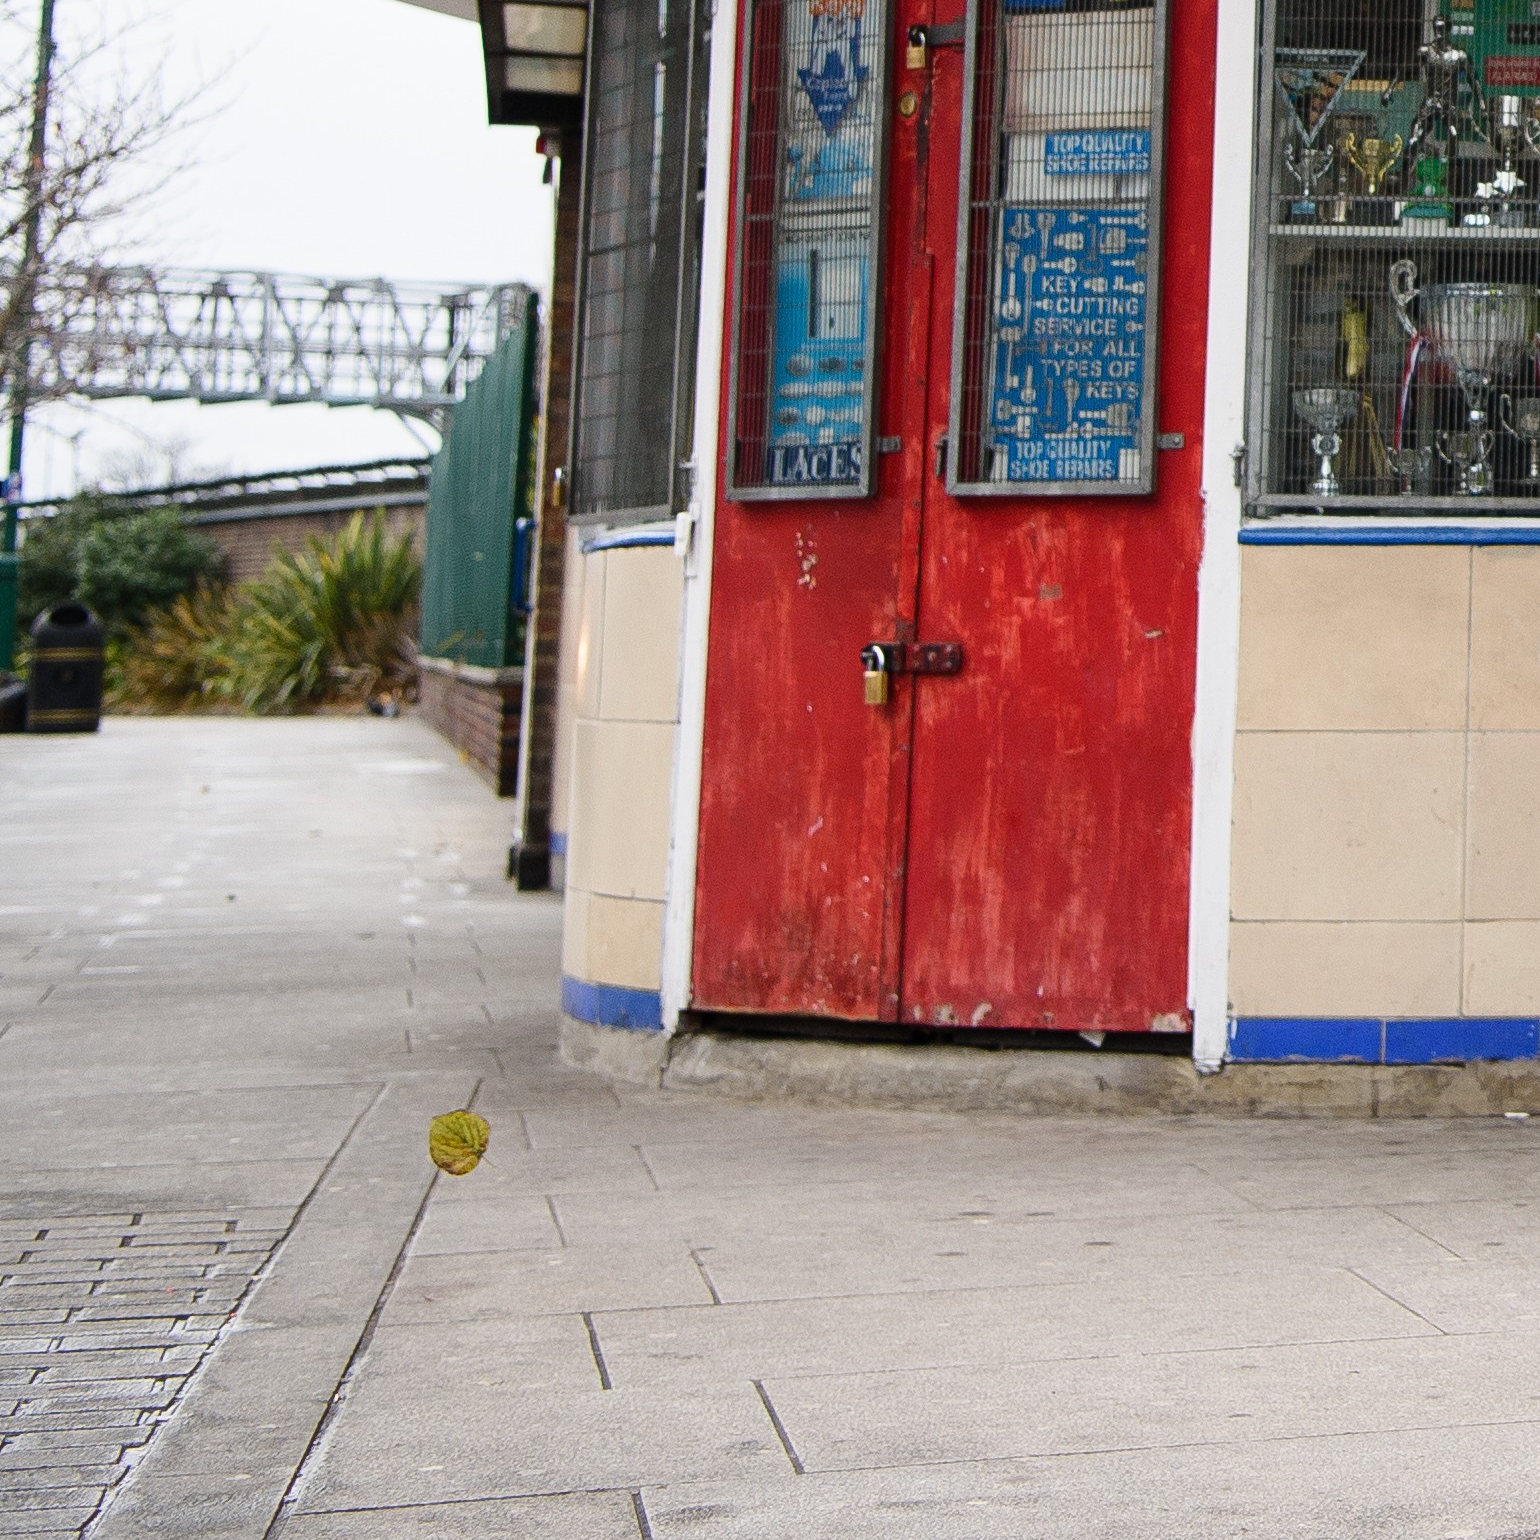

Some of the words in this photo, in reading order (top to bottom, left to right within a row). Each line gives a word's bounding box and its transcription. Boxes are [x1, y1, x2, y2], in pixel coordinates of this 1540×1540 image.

[1053, 134, 1081, 153] TOP
[1082, 132, 1144, 152] QUALITY
[1041, 274, 1081, 293] KEY
[1056, 296, 1140, 316] CUTTING
[1033, 317, 1118, 337] SERVICE
[1053, 339, 1094, 356] FOR
[1102, 338, 1142, 357] ALL
[1041, 359, 1103, 377] TYPES
[1108, 360, 1137, 378] OF
[1086, 381, 1140, 399] KEYS
[1016, 441, 1045, 460] TOP
[1047, 440, 1112, 460] QUALITY
[772, 444, 860, 480] LACES
[1010, 460, 1050, 478] SHOE
[1055, 459, 1114, 478] REPAIRS
